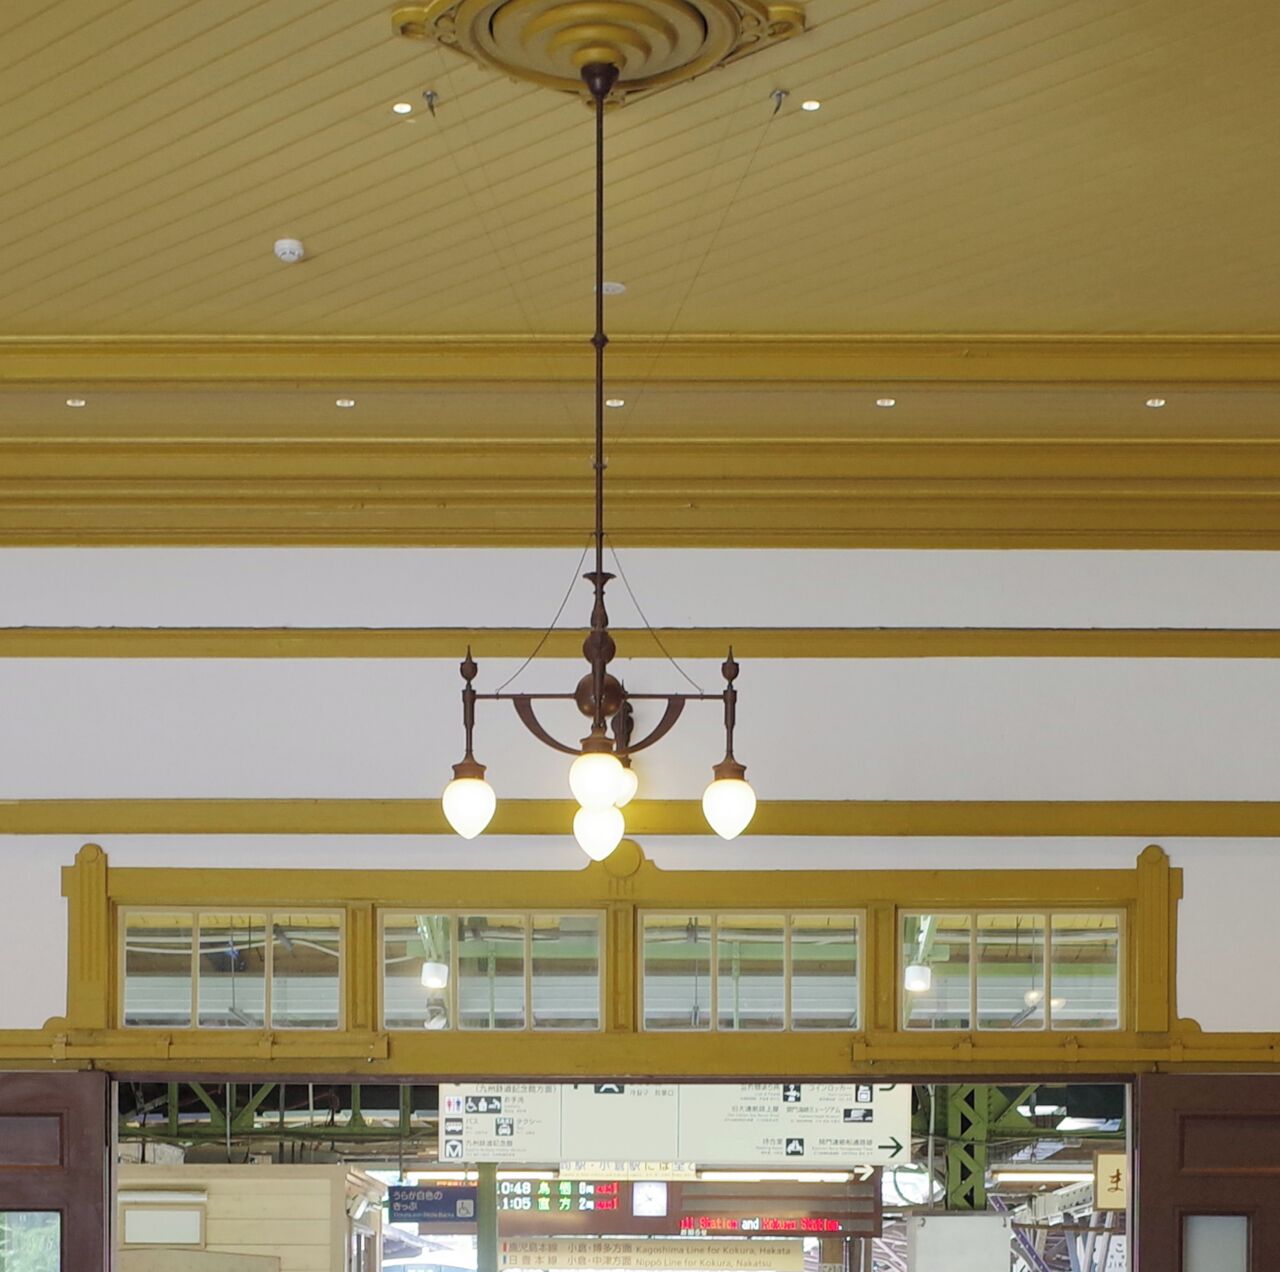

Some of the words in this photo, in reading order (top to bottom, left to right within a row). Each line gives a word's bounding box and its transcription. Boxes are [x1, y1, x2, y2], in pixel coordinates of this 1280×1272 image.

[496, 1181, 531, 1194] 0:48
[393, 1191, 443, 1201] うらが白色の
[393, 1202, 418, 1211] きっぷ
[496, 1198, 531, 1210] 1:05
[699, 1217, 737, 1229] Station
[742, 1217, 759, 1230] and
[509, 1242, 558, 1252] 鹿児島本線
[568, 1243, 632, 1253] 小倉・博多方面
[636, 1245, 684, 1256] Kagoshima
[687, 1245, 705, 1254] Line
[708, 1245, 719, 1254] for
[723, 1246, 756, 1255] Kokura,
[760, 1246, 790, 1255] Hakata
[568, 1255, 632, 1265] 小倉・中津方面
[664, 1258, 681, 1267] Line
[684, 1258, 696, 1267] for
[700, 1258, 733, 1268] Kokura,
[737, 1259, 772, 1267] Nakatsu
